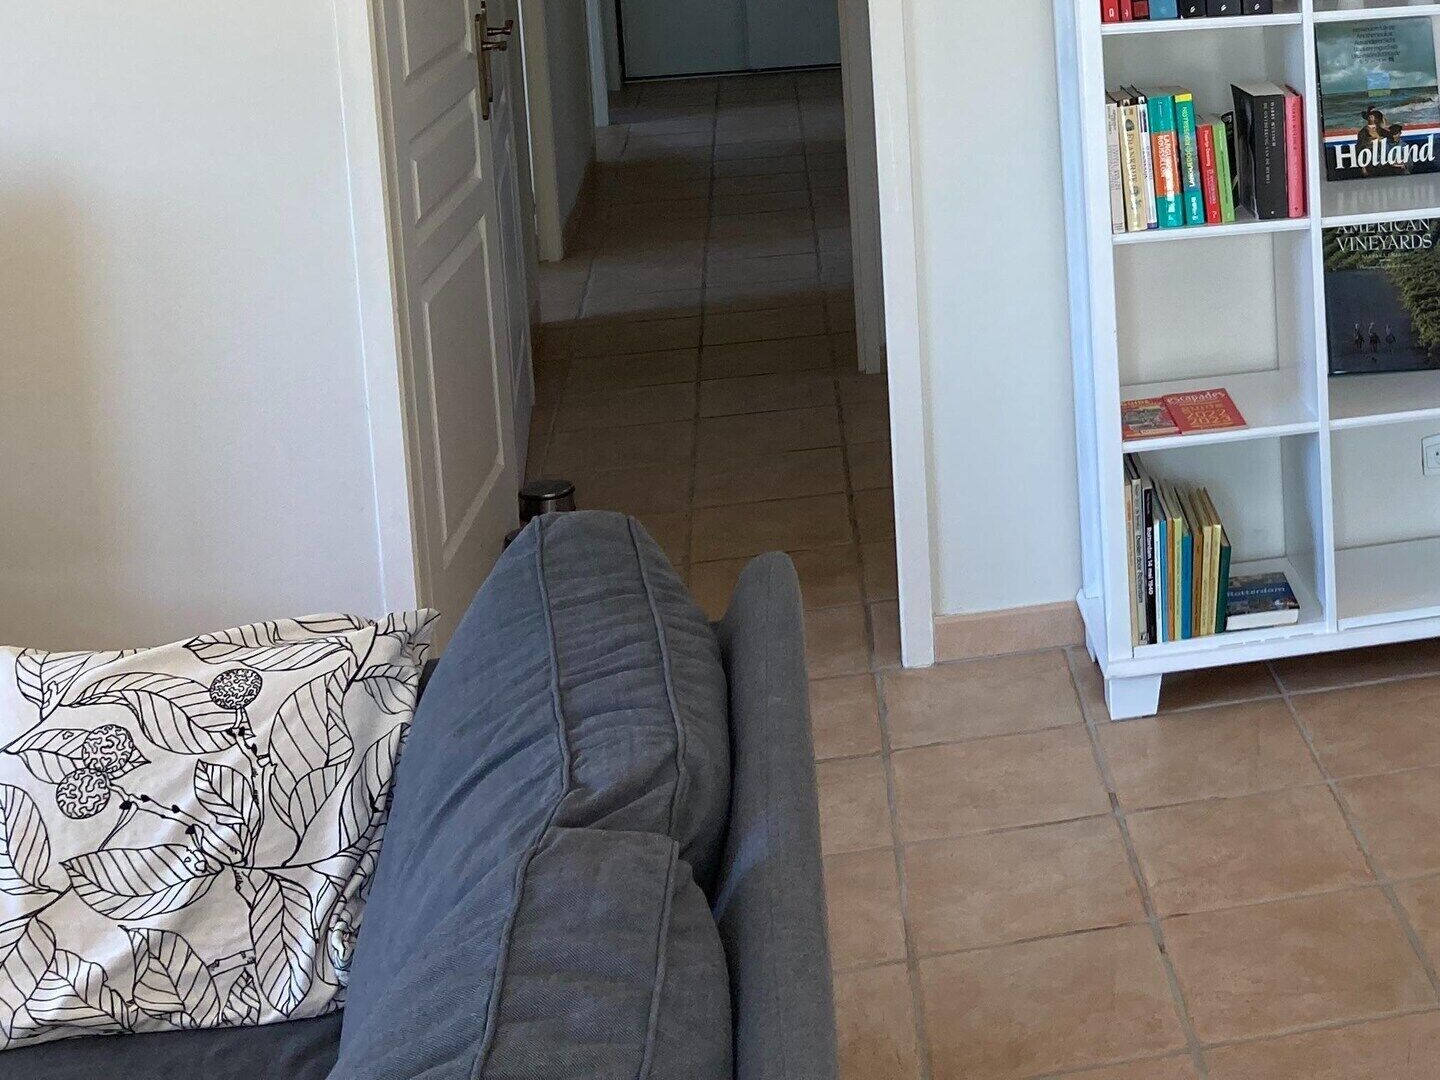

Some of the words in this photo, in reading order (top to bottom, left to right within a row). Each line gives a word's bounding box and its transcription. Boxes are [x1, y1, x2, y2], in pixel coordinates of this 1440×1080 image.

[1334, 134, 1436, 169] Holland
[1336, 233, 1433, 252] VINEYARDS
[1227, 587, 1286, 598] Rotterdam
